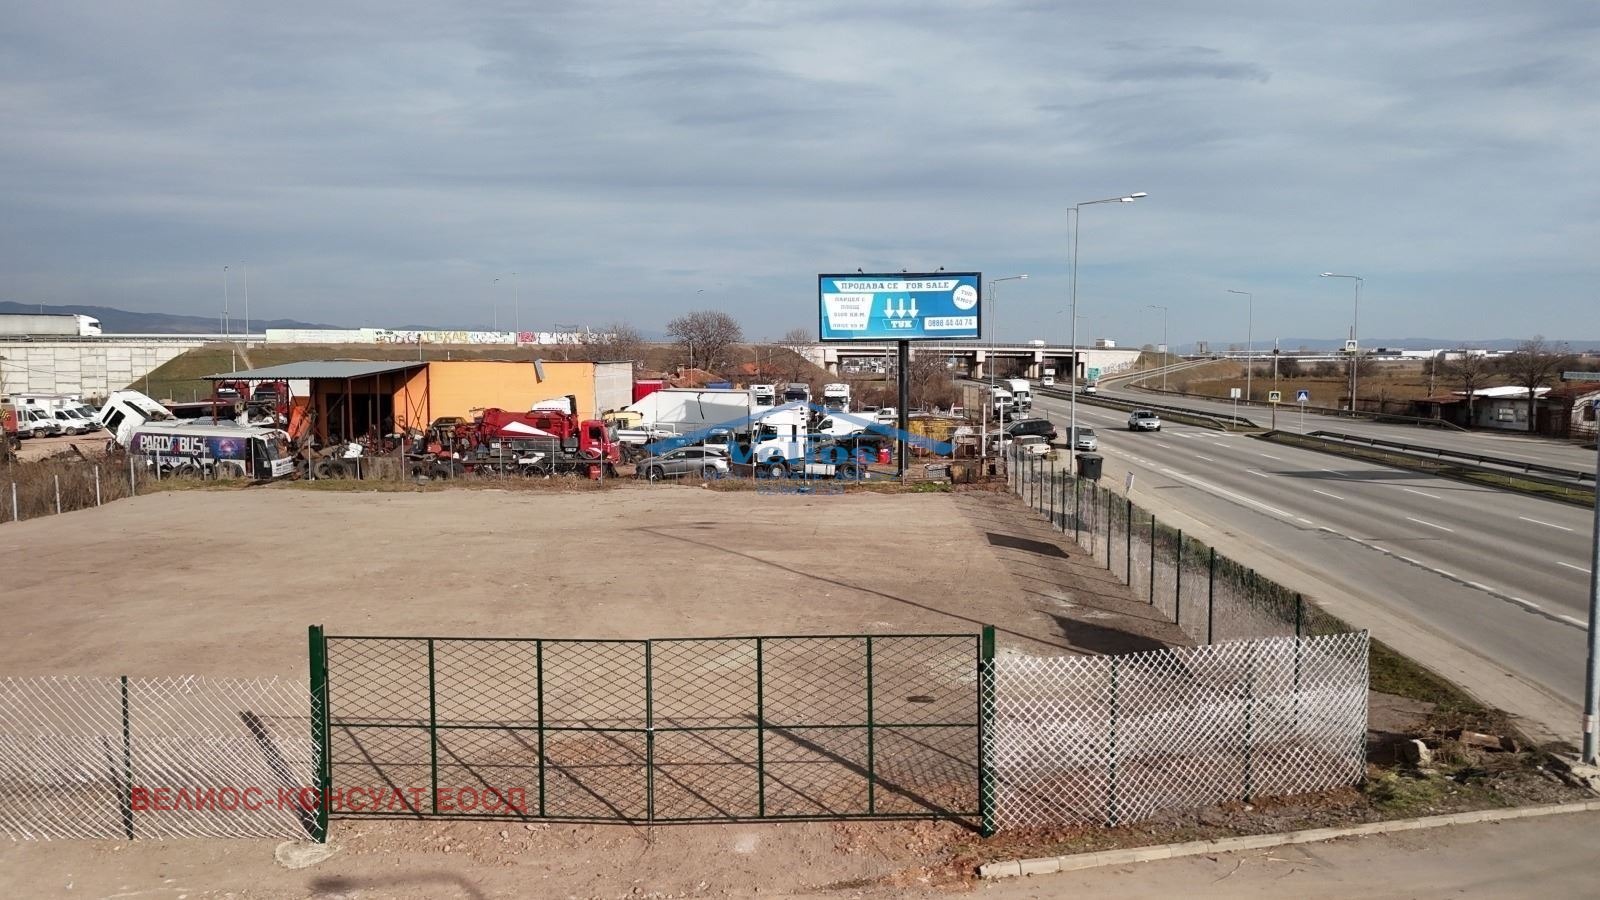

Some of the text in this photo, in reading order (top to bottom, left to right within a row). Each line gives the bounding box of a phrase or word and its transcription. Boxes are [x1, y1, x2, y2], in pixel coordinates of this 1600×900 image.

[841, 282, 898, 291] ПРОДАВА СЕ
[926, 281, 949, 289] SALE
[927, 319, 944, 327] 0888
[140, 434, 204, 453] PARTY BUS
